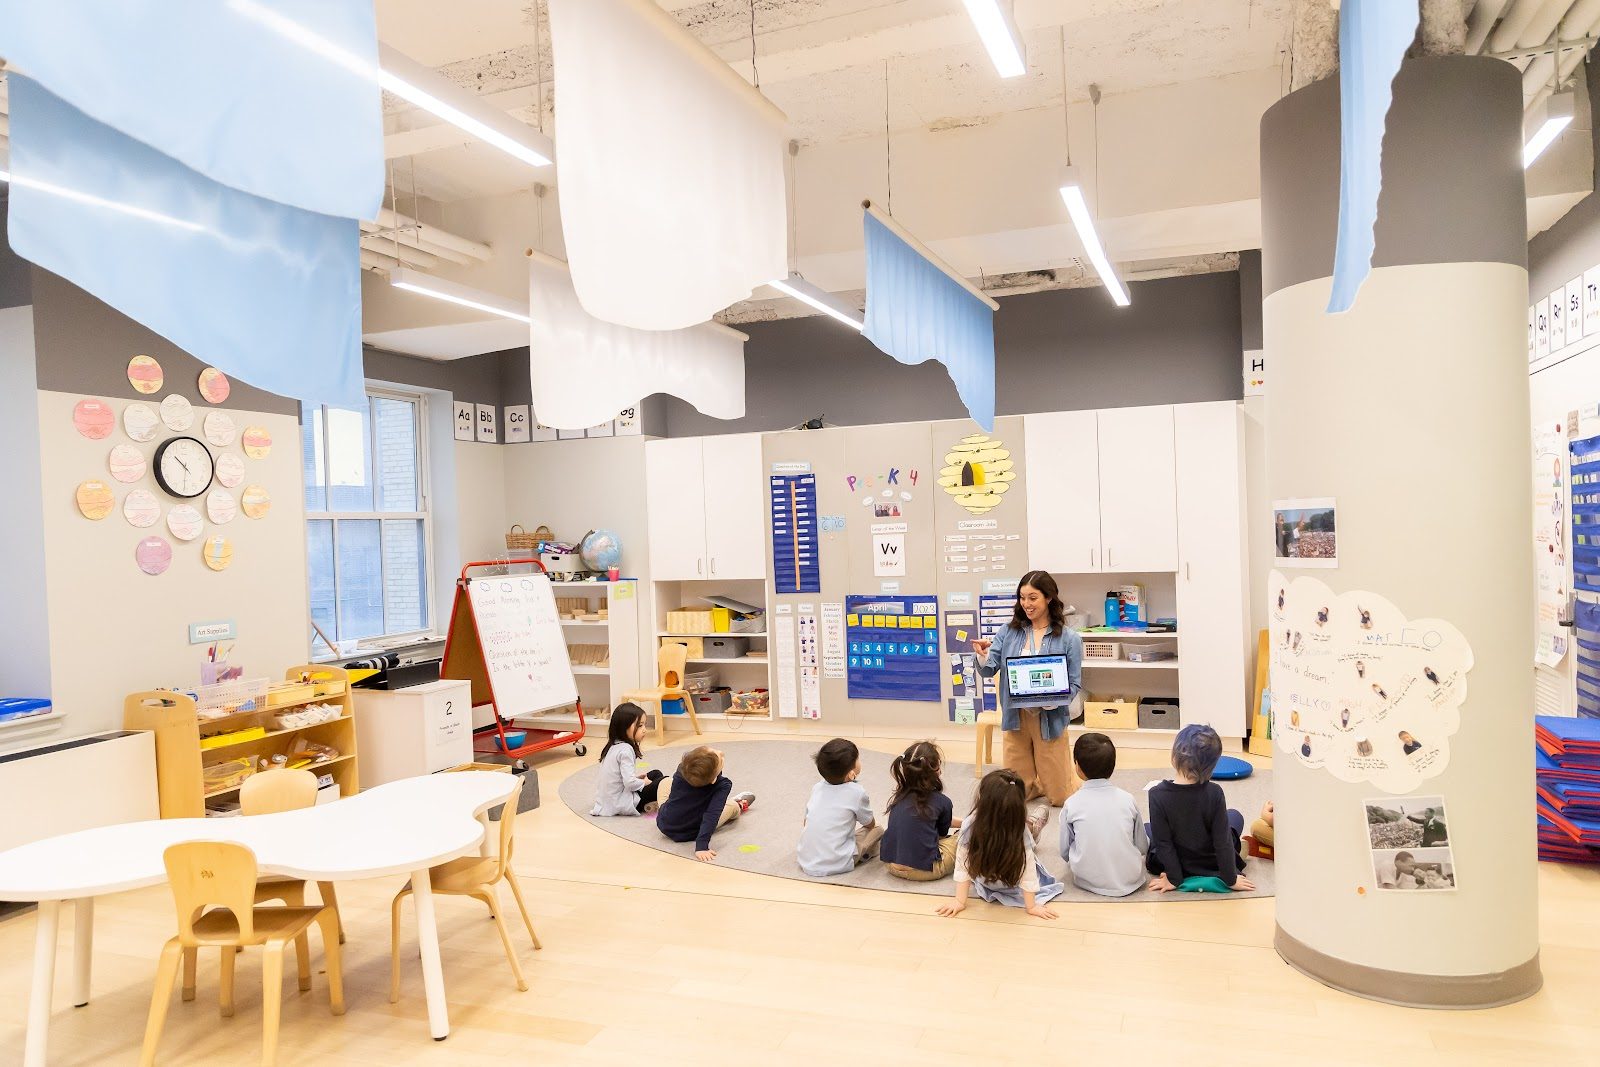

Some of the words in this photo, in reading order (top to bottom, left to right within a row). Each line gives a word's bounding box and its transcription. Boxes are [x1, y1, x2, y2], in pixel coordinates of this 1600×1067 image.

[1570, 294, 1579, 311] Ss
[458, 409, 470, 420] Aa
[480, 411, 492, 423] Bb
[510, 412, 524, 423] Cc
[910, 469, 918, 486] 4
[881, 543, 897, 554] Vv
[867, 603, 887, 613] April
[913, 604, 936, 613] 2023
[928, 631, 933, 640] 1
[852, 643, 858, 651] 2
[864, 644, 870, 652] 3
[876, 644, 881, 652] 4
[927, 645, 933, 653] 8
[851, 657, 857, 665] 9
[864, 658, 871, 666] 10
[875, 658, 882, 666] 11
[445, 701, 453, 716] 2
